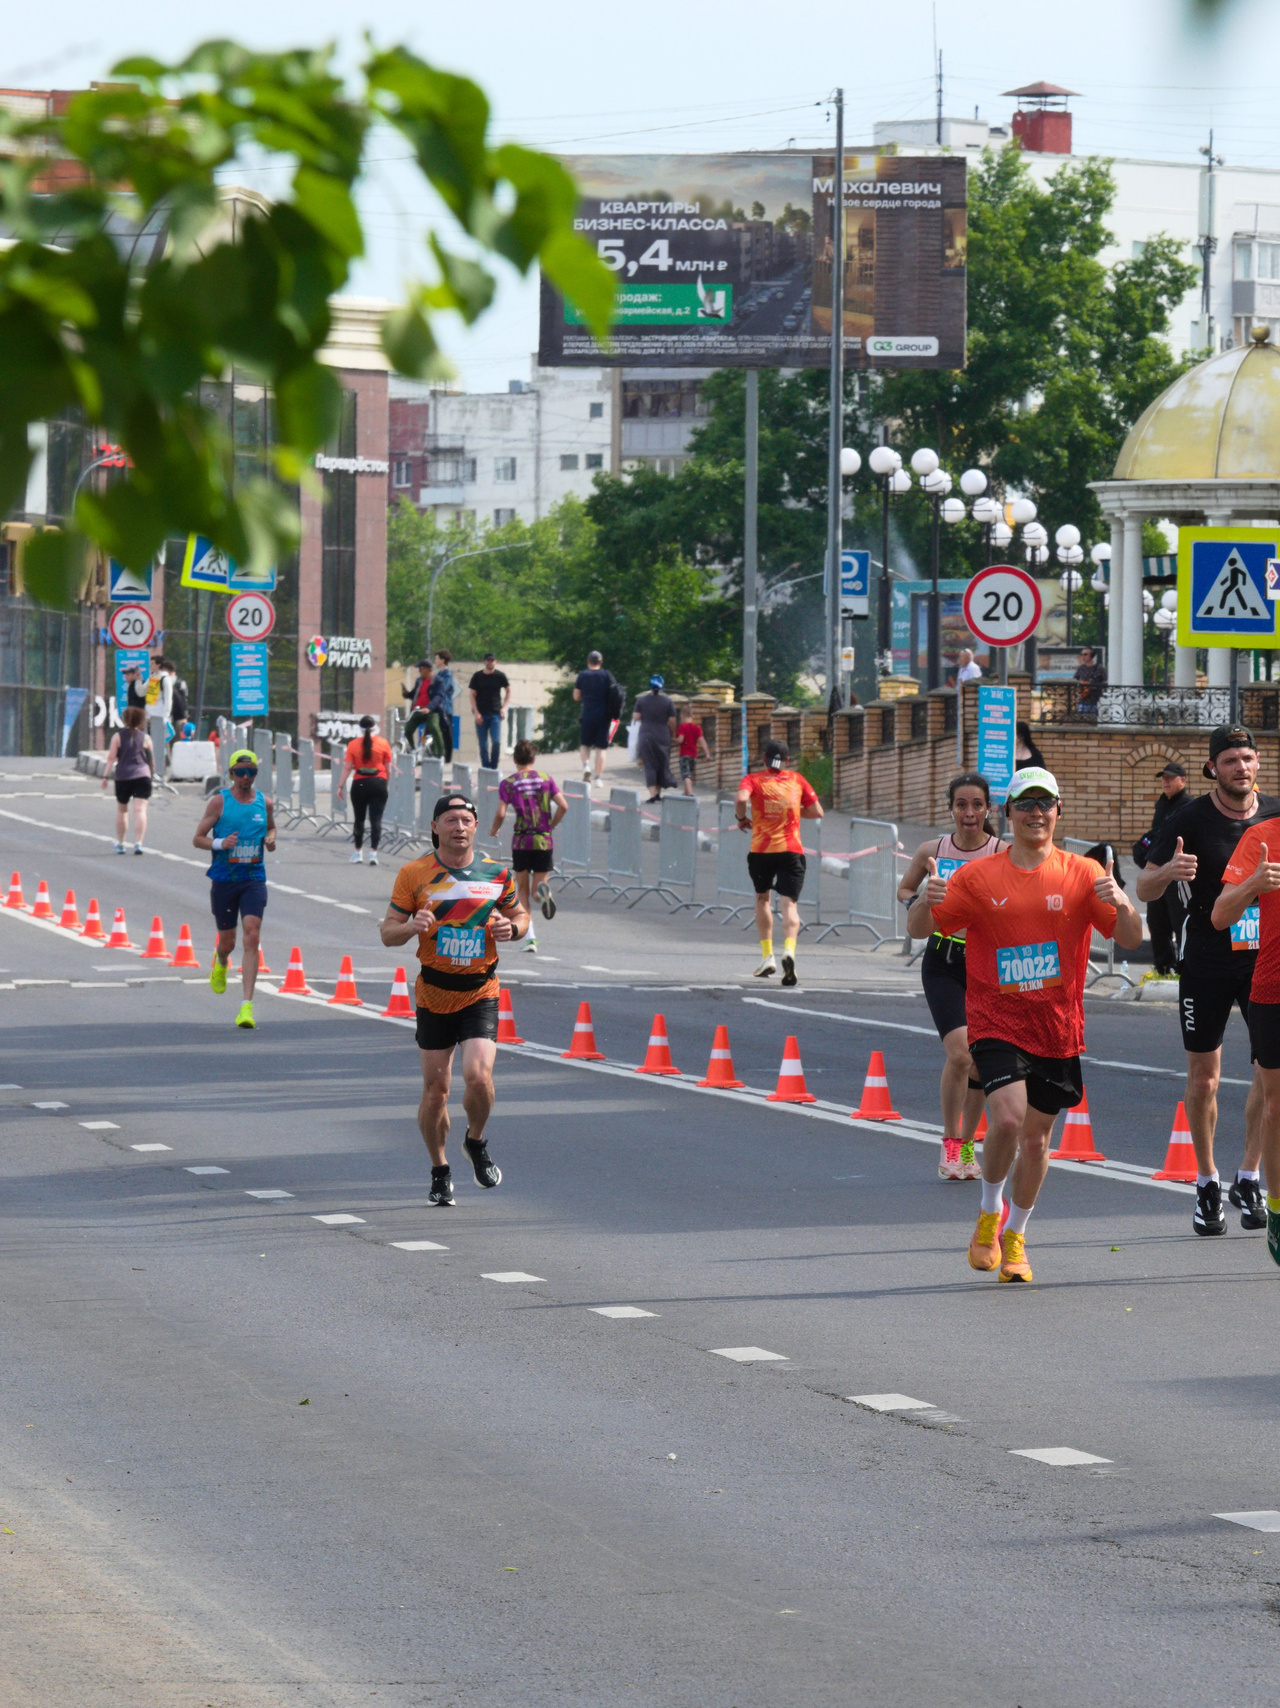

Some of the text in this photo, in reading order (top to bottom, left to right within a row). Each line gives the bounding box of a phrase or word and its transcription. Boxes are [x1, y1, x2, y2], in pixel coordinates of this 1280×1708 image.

[600, 202, 700, 214] КВАРТИРЫ
[827, 198, 941, 209] Нвое сердце города
[573, 218, 728, 231] БИЗНЕС-КЛАССА
[597, 239, 674, 277] 5,4
[895, 344, 932, 352] GROUP
[982, 591, 1023, 622] 20
[238, 608, 263, 626] 20
[120, 618, 144, 635] 20
[328, 637, 372, 652] АПТЕКА
[327, 651, 372, 668] РИГЛА
[1046, 894, 1063, 911] 10
[442, 937, 482, 957] 70124
[1001, 954, 1057, 982] 70022
[1019, 979, 1044, 992] 21.1KM
